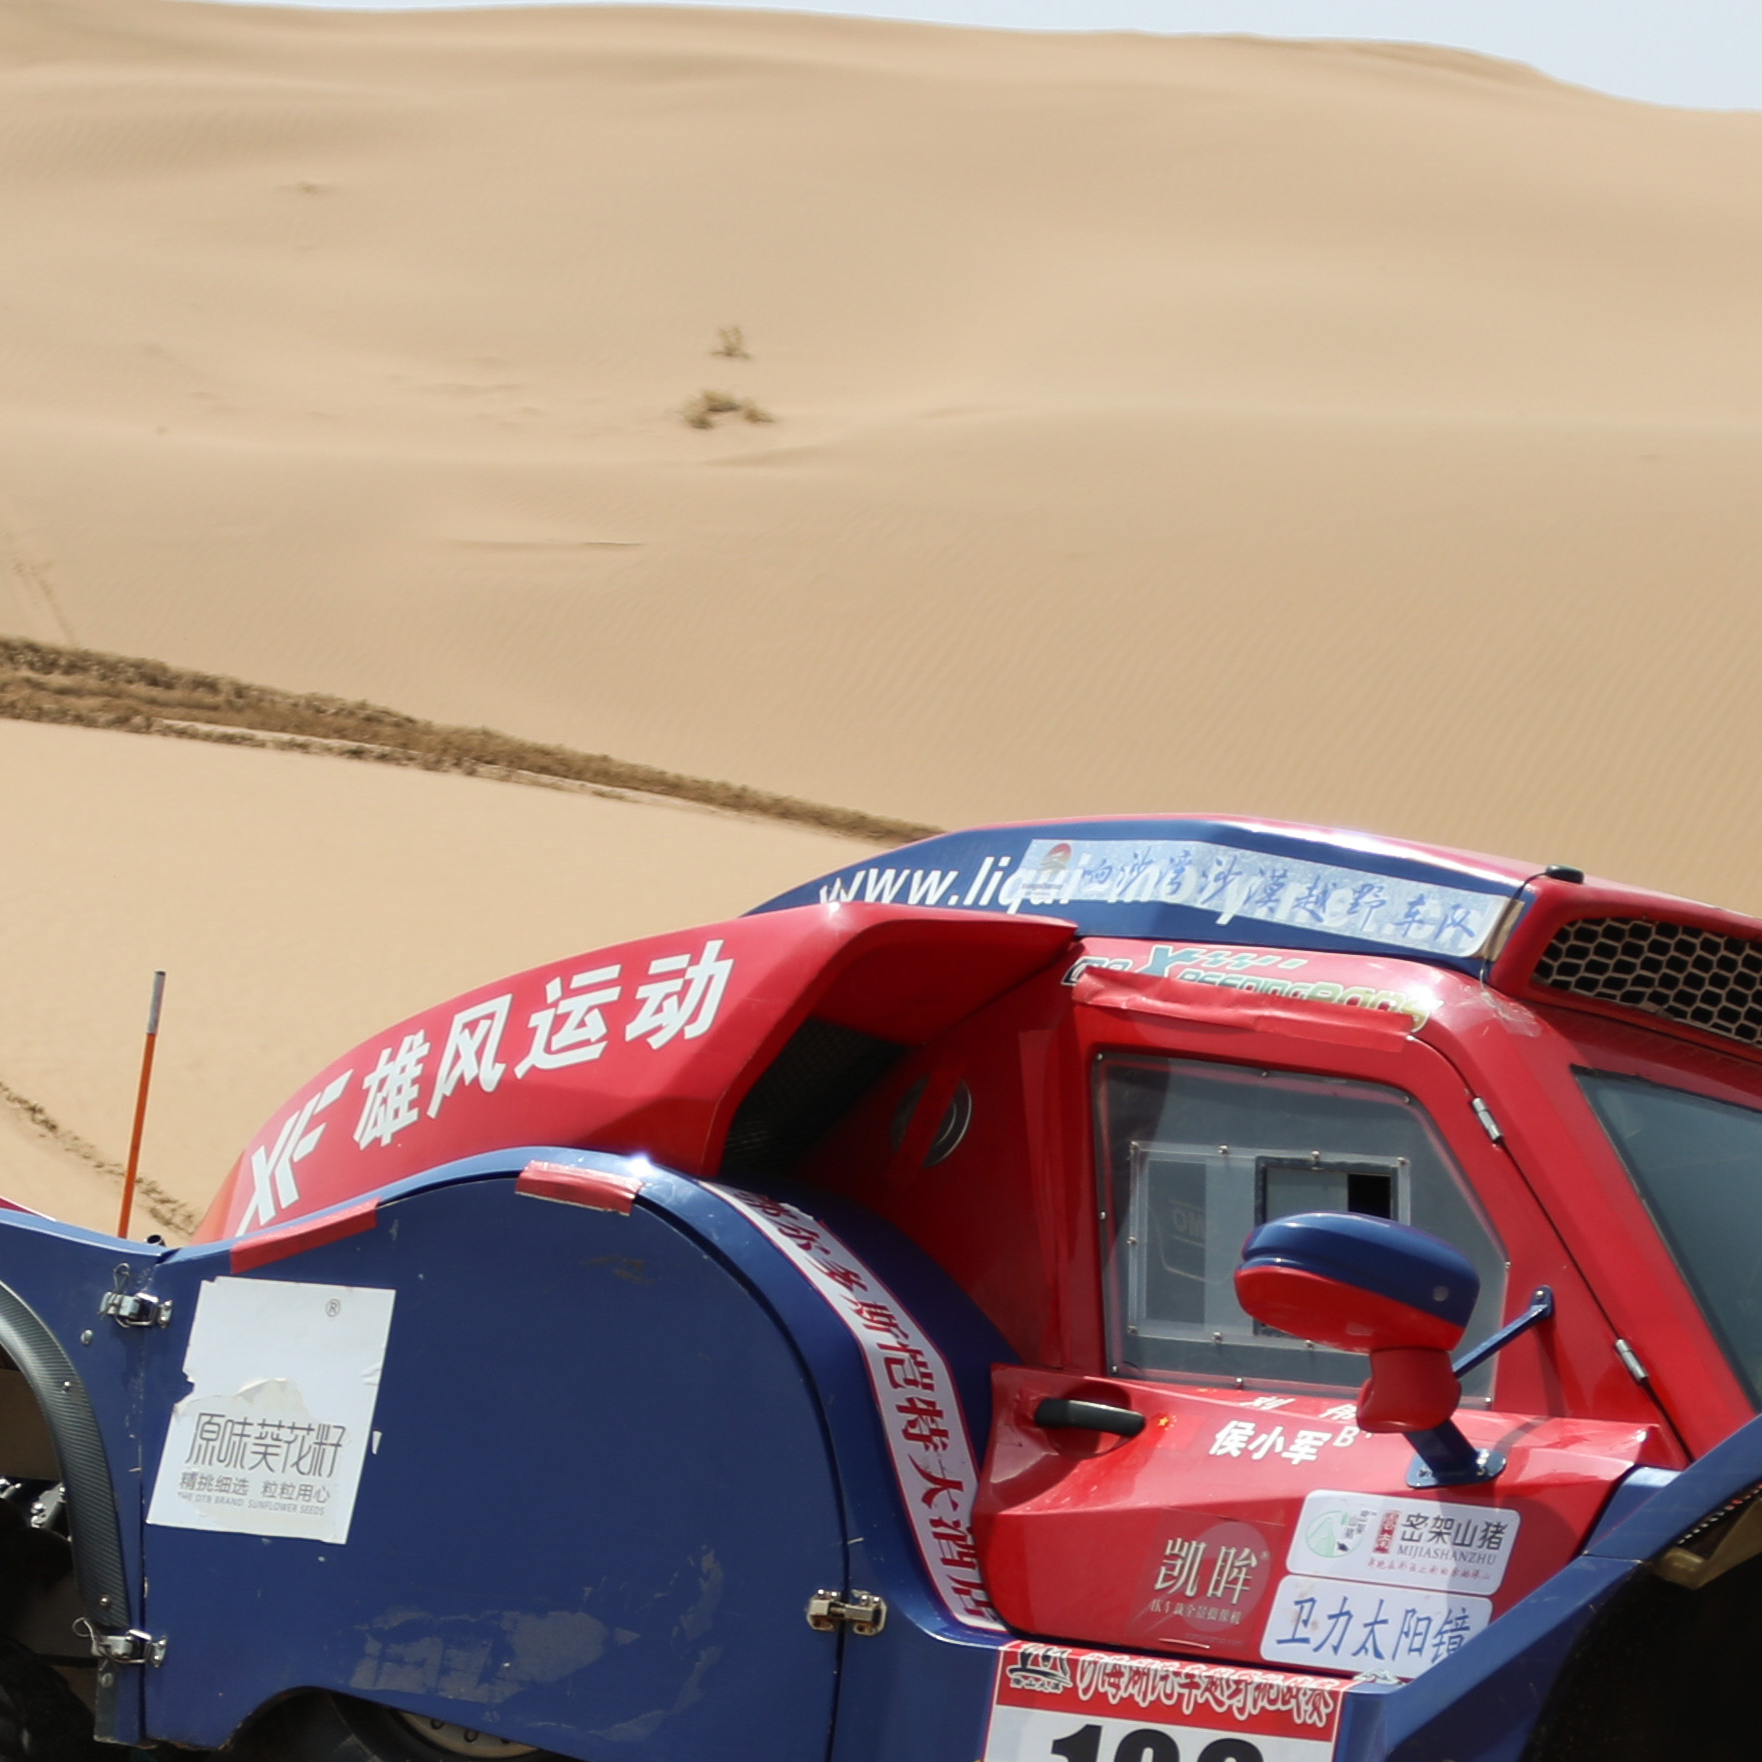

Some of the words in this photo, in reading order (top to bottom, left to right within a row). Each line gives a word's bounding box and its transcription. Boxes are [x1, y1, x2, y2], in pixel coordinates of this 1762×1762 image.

[352, 939, 736, 1150] 雄风运动
[184, 1412, 347, 1479] 原味葵花籽
[1208, 1420, 1333, 1466] 侯小军
[178, 1471, 250, 1497] 精挑细选
[260, 1479, 332, 1504] 粒粒用心
[214, 1495, 245, 1508] BRAND
[247, 1498, 298, 1513] SUNFLOWER
[299, 1503, 326, 1517] SEEDS
[1400, 1511, 1509, 1552] 密架山猪
[1154, 1537, 1258, 1605] 凯眸
[1396, 1543, 1498, 1567] MIJIASHANZHU
[1275, 1595, 1472, 1664] 卫力太阳镜
